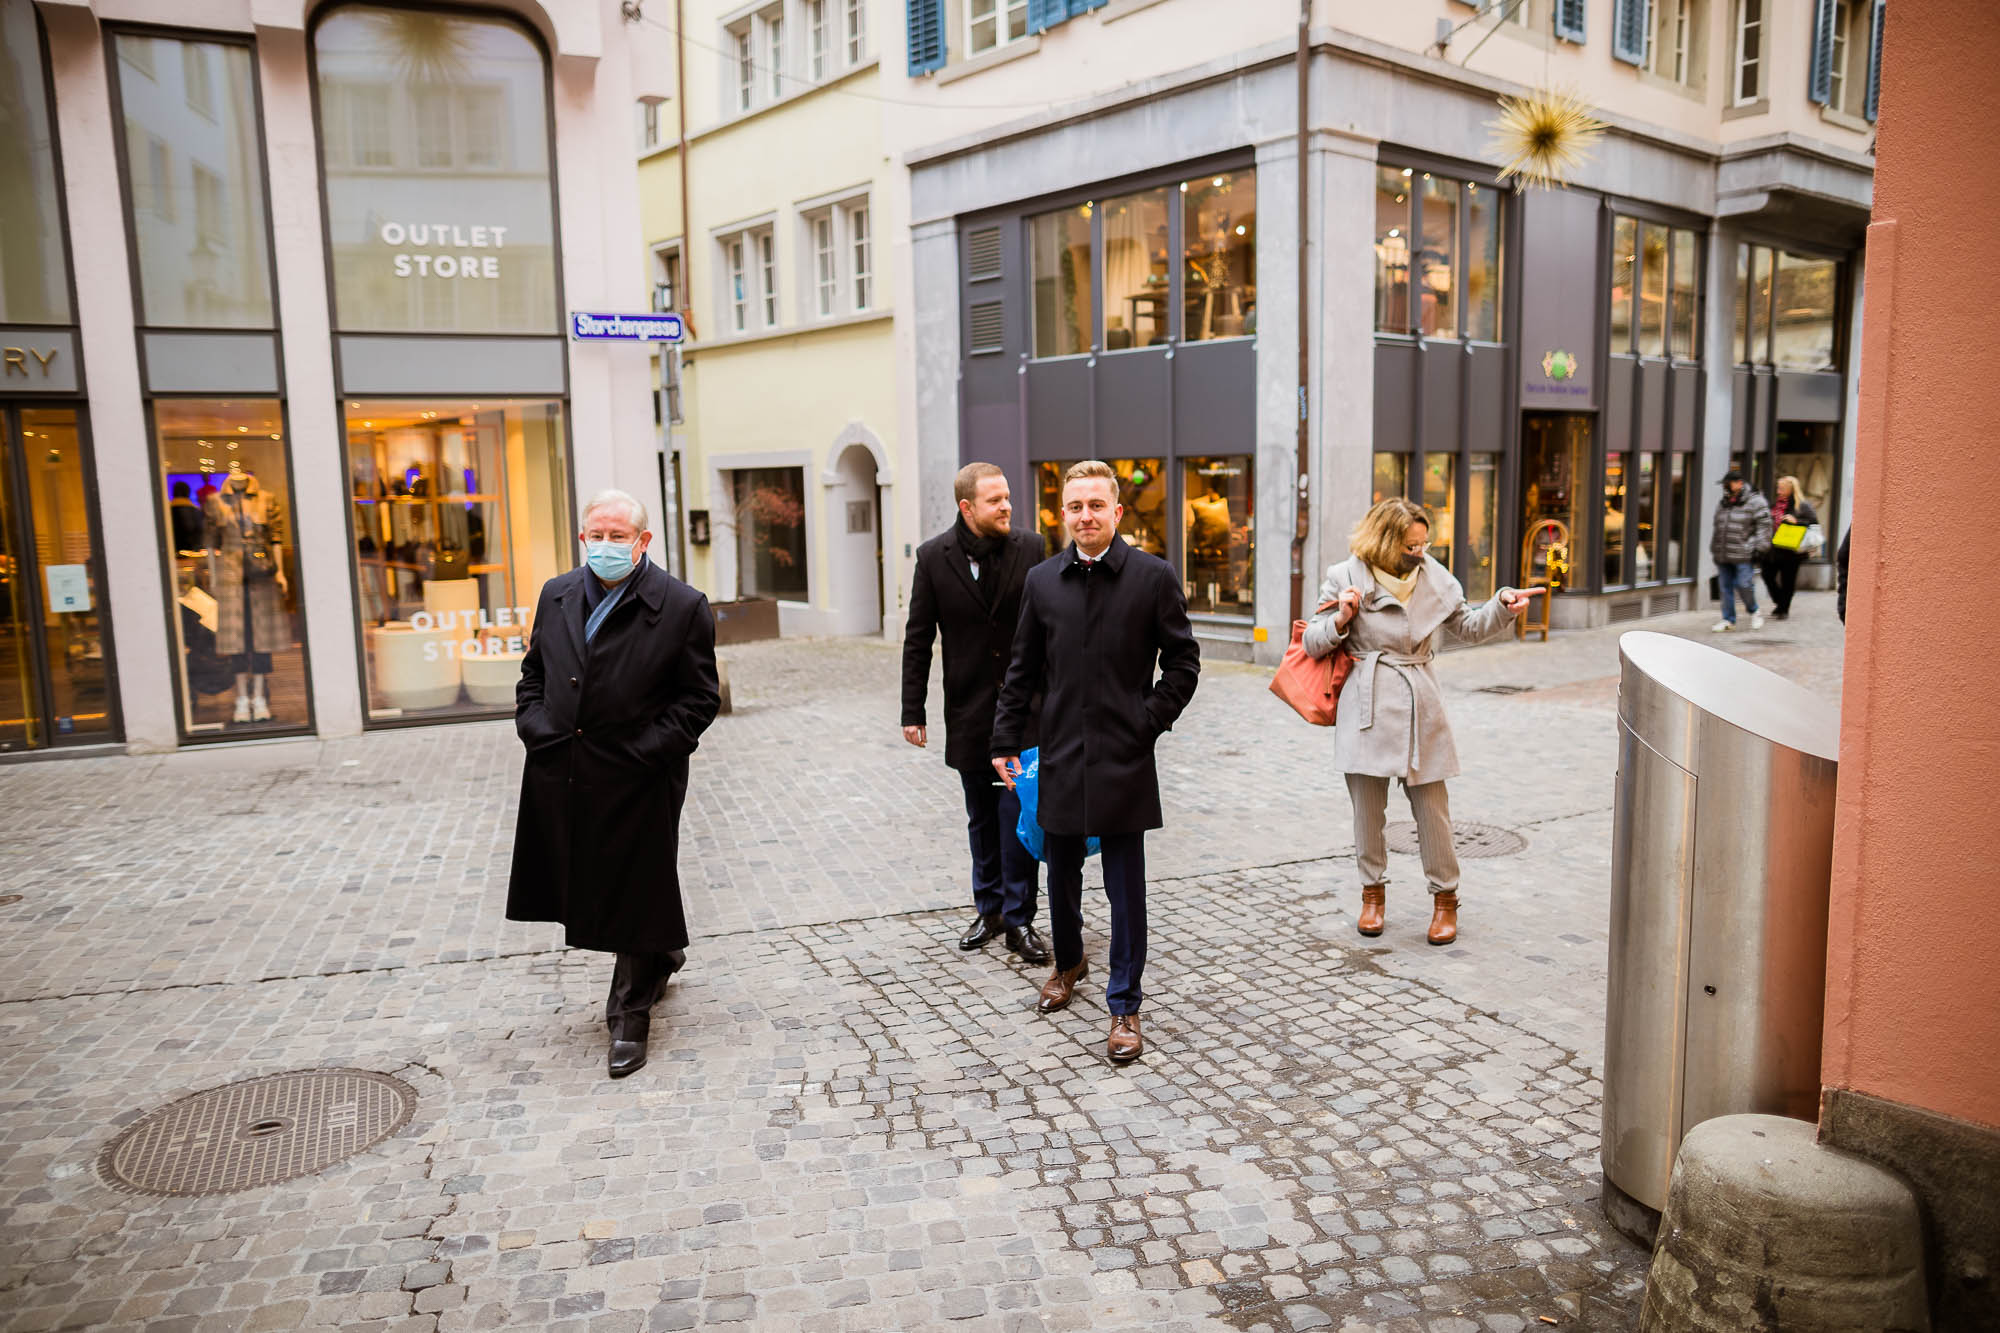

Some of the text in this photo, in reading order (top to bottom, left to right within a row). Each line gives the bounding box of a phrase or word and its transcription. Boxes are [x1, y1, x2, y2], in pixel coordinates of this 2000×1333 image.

[381, 222, 507, 248] OUTLET
[394, 254, 500, 278] STORE
[577, 314, 680, 340] Storchengasse
[3, 347, 57, 377] RY
[410, 607, 531, 632] OUTLET
[423, 635, 523, 661] STORE
